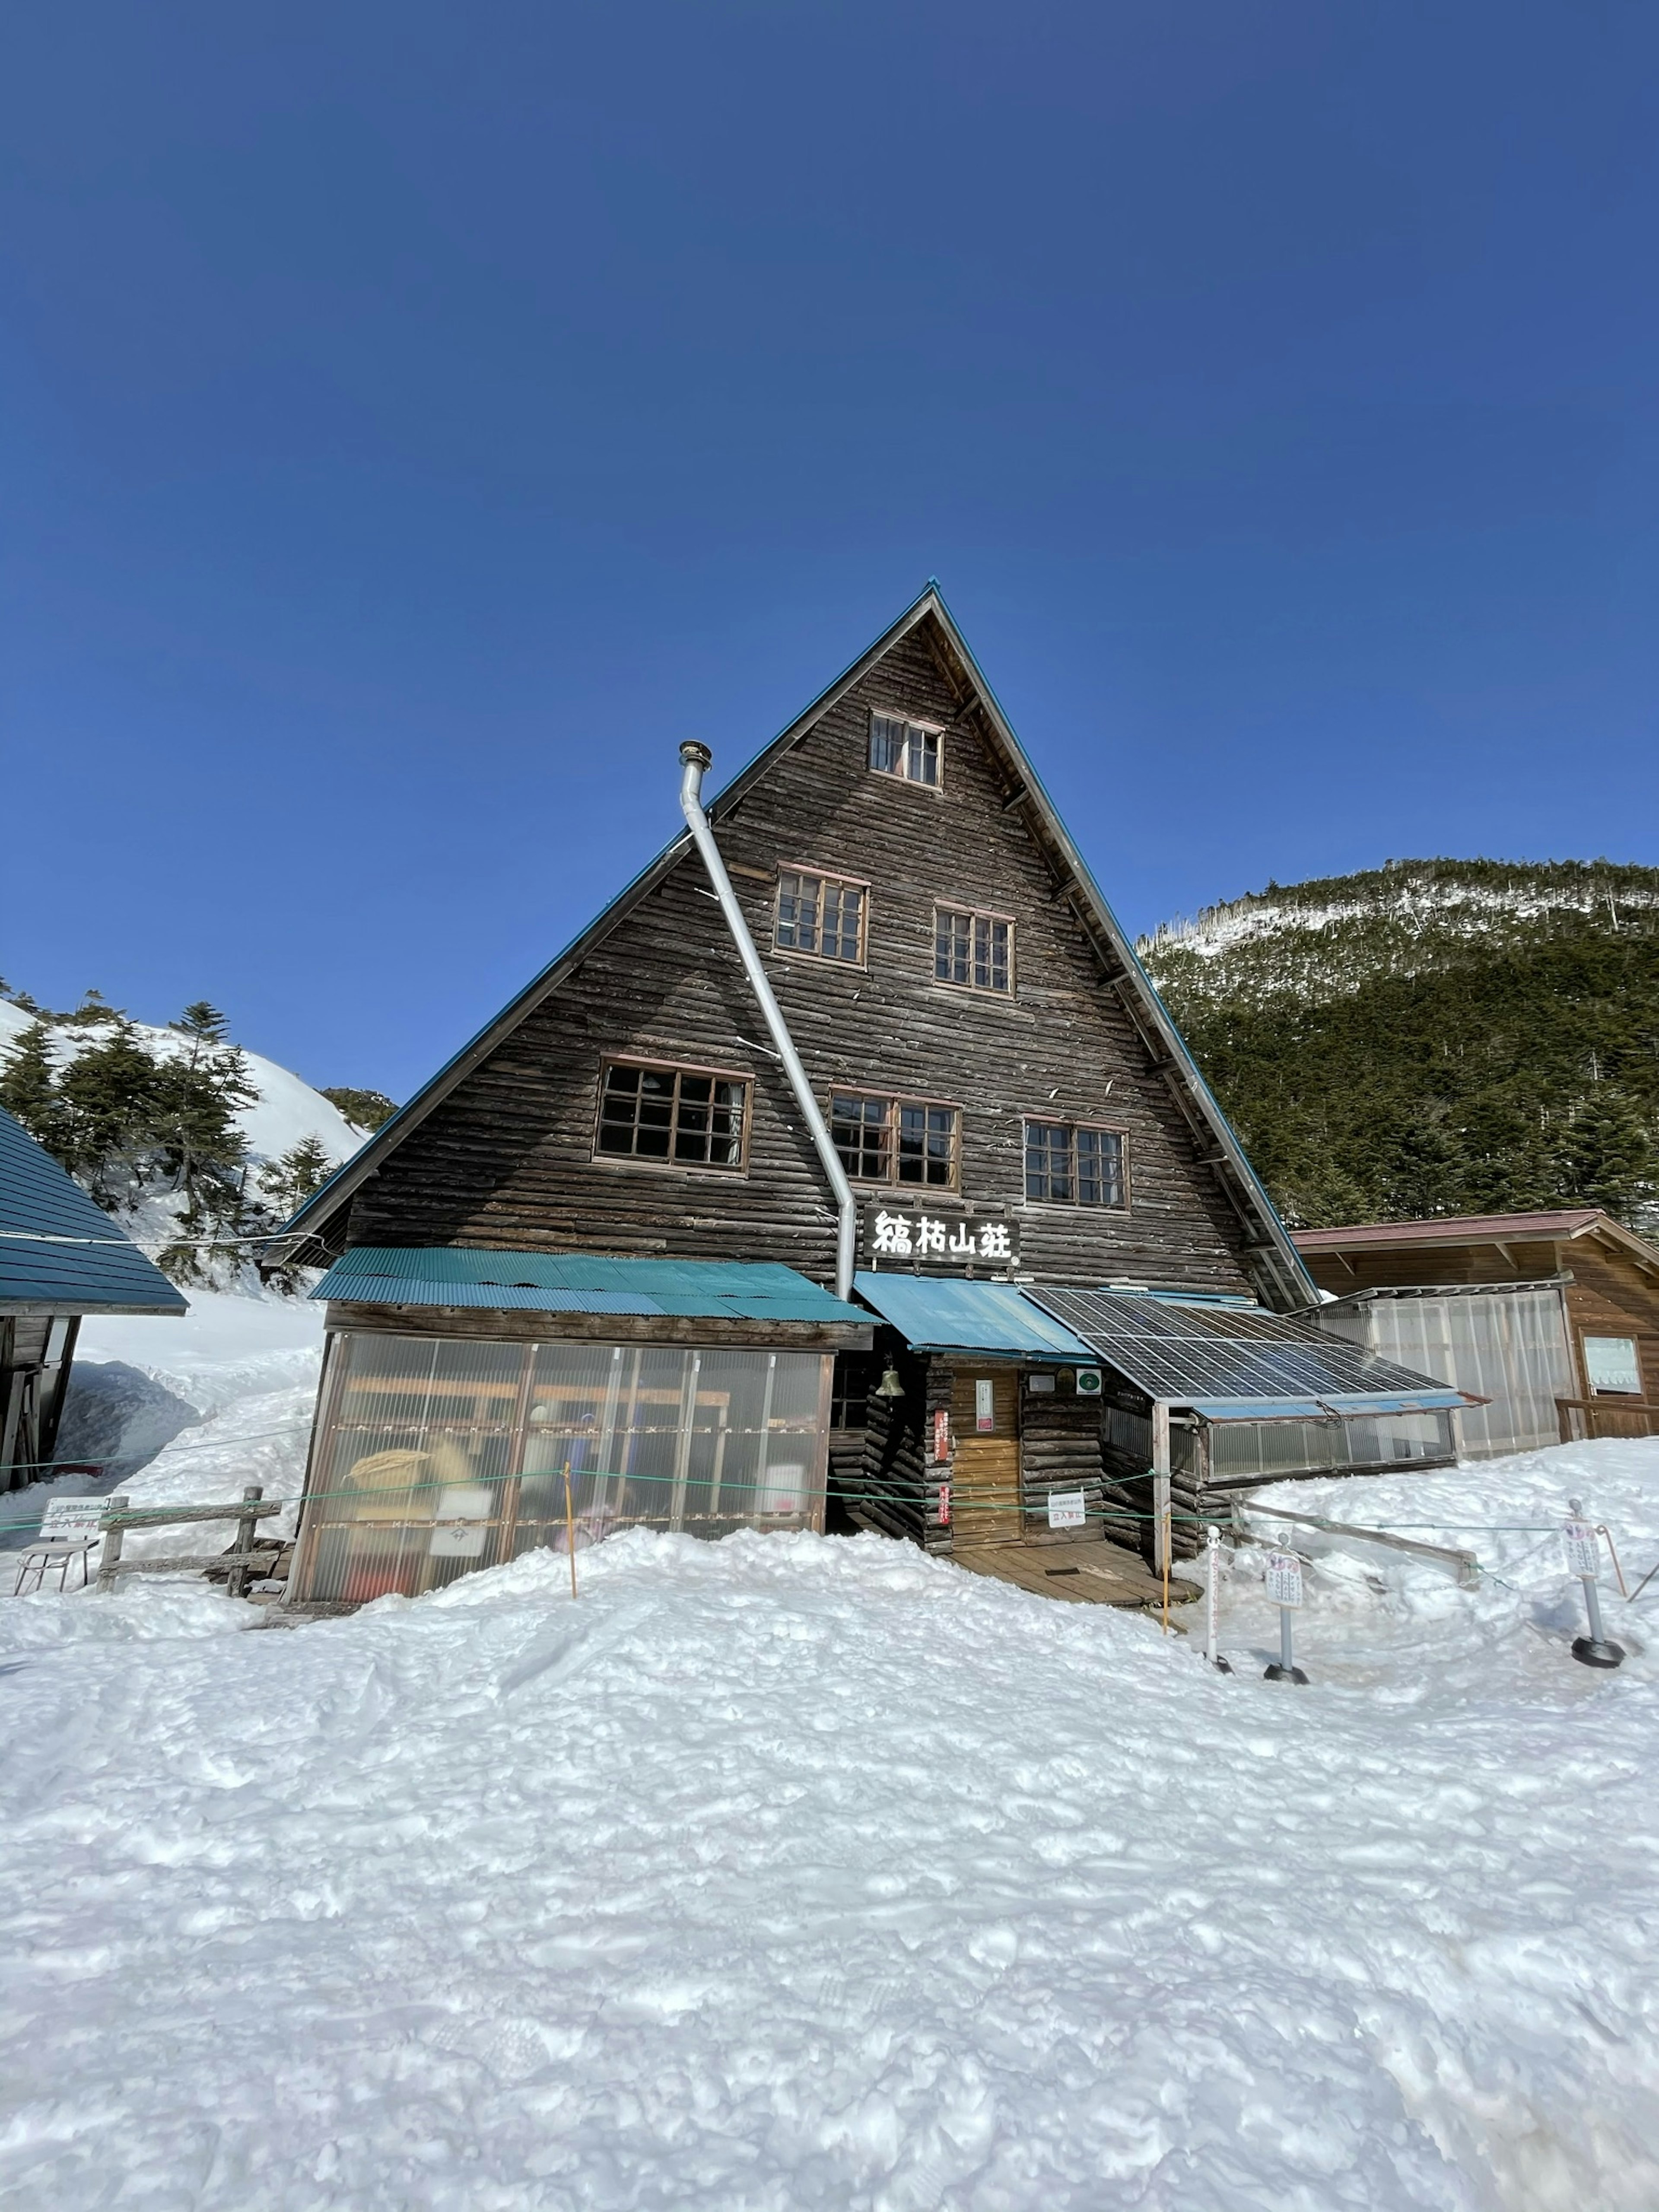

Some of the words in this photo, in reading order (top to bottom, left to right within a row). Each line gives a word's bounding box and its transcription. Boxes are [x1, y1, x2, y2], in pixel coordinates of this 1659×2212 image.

[872, 1210, 1012, 1258] 縞枯山荘
[1054, 1512, 1081, 1520] 立入禁止
[49, 1519, 97, 1529] 立入禁止
